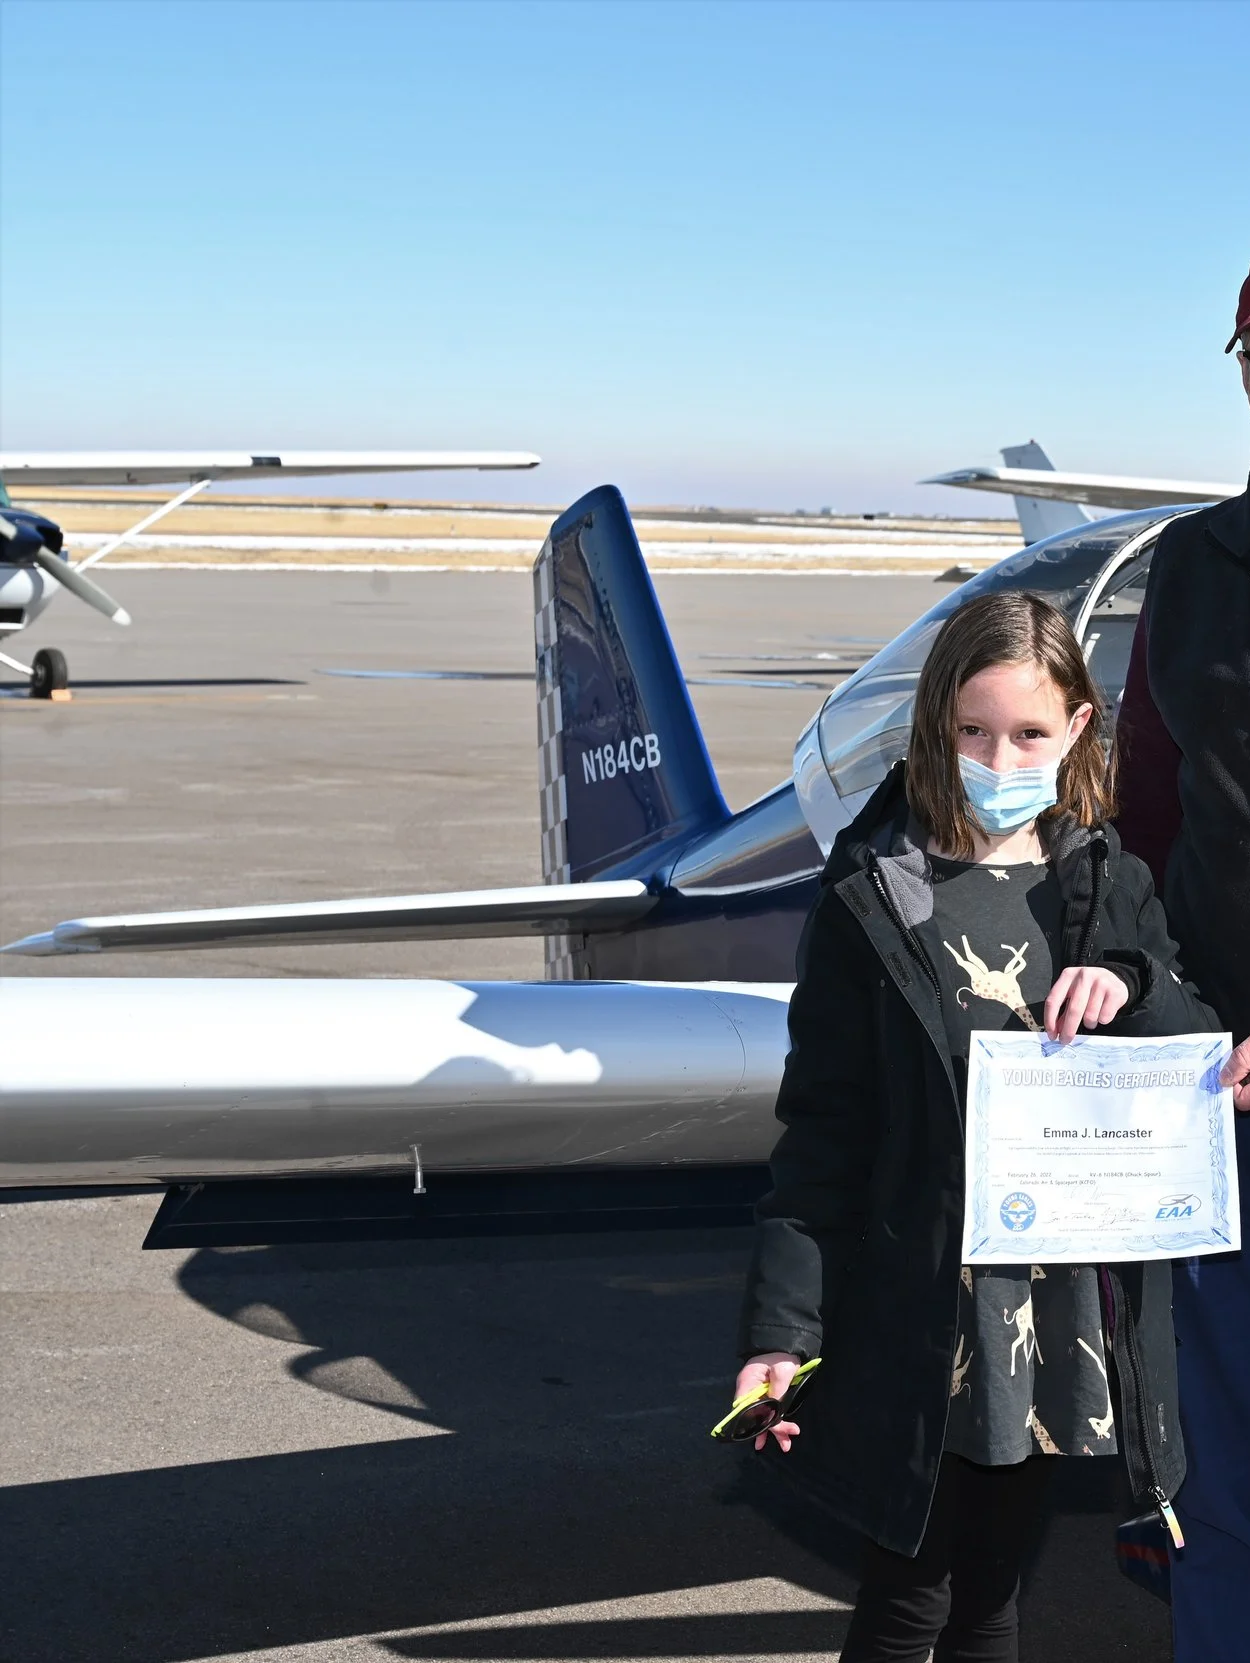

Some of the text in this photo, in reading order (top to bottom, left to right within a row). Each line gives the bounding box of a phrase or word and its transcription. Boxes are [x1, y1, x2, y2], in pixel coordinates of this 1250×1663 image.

[581, 733, 661, 785] N184CB
[1003, 1068, 1195, 1089] YOUNG EAGLES CERTIFICATE
[1043, 1127, 1153, 1139] Emma J. Lancaster
[1155, 1205, 1193, 1219] EAA
